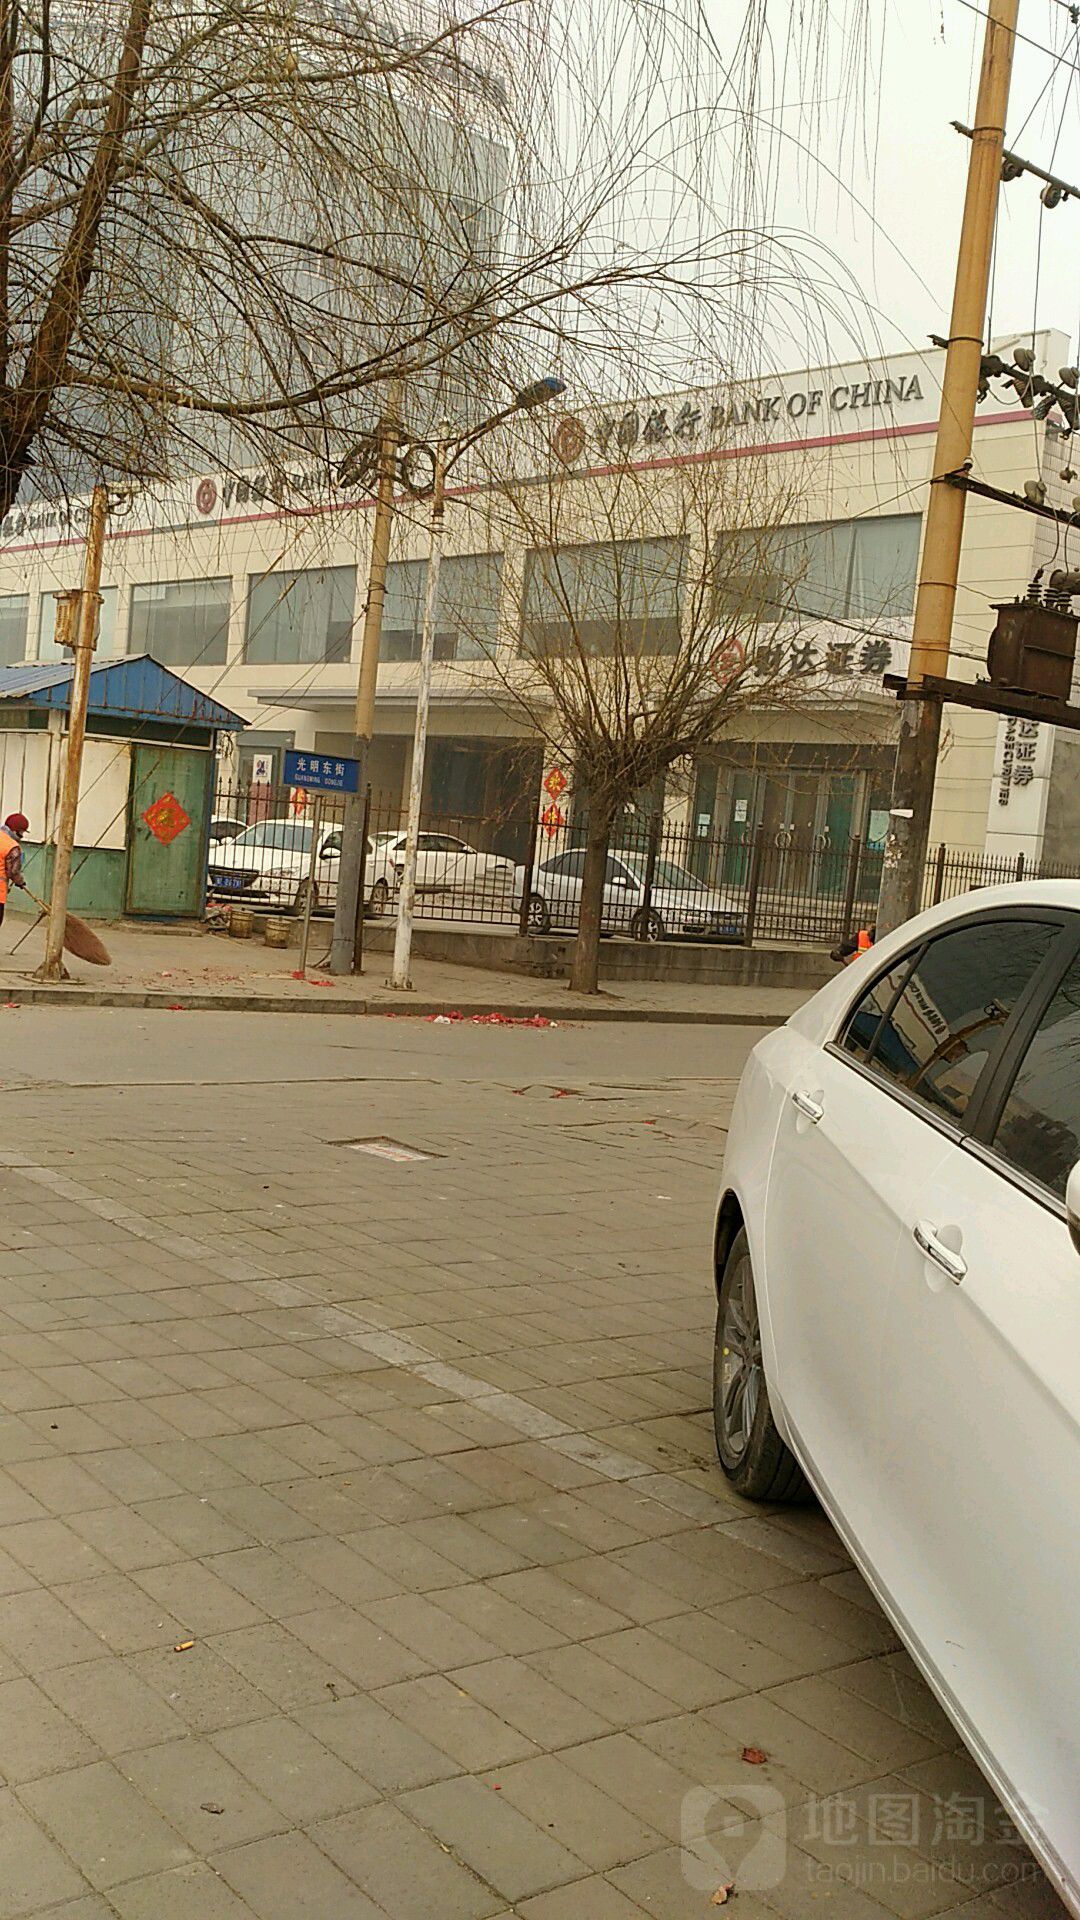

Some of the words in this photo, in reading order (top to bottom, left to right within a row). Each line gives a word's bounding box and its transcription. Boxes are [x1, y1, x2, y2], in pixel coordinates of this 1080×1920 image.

[710, 396, 783, 431] BANK
[786, 389, 823, 418] OF
[829, 374, 924, 411] CHINA
[753, 639, 893, 678] 财达证券
[296, 757, 345, 777] 光明东街
